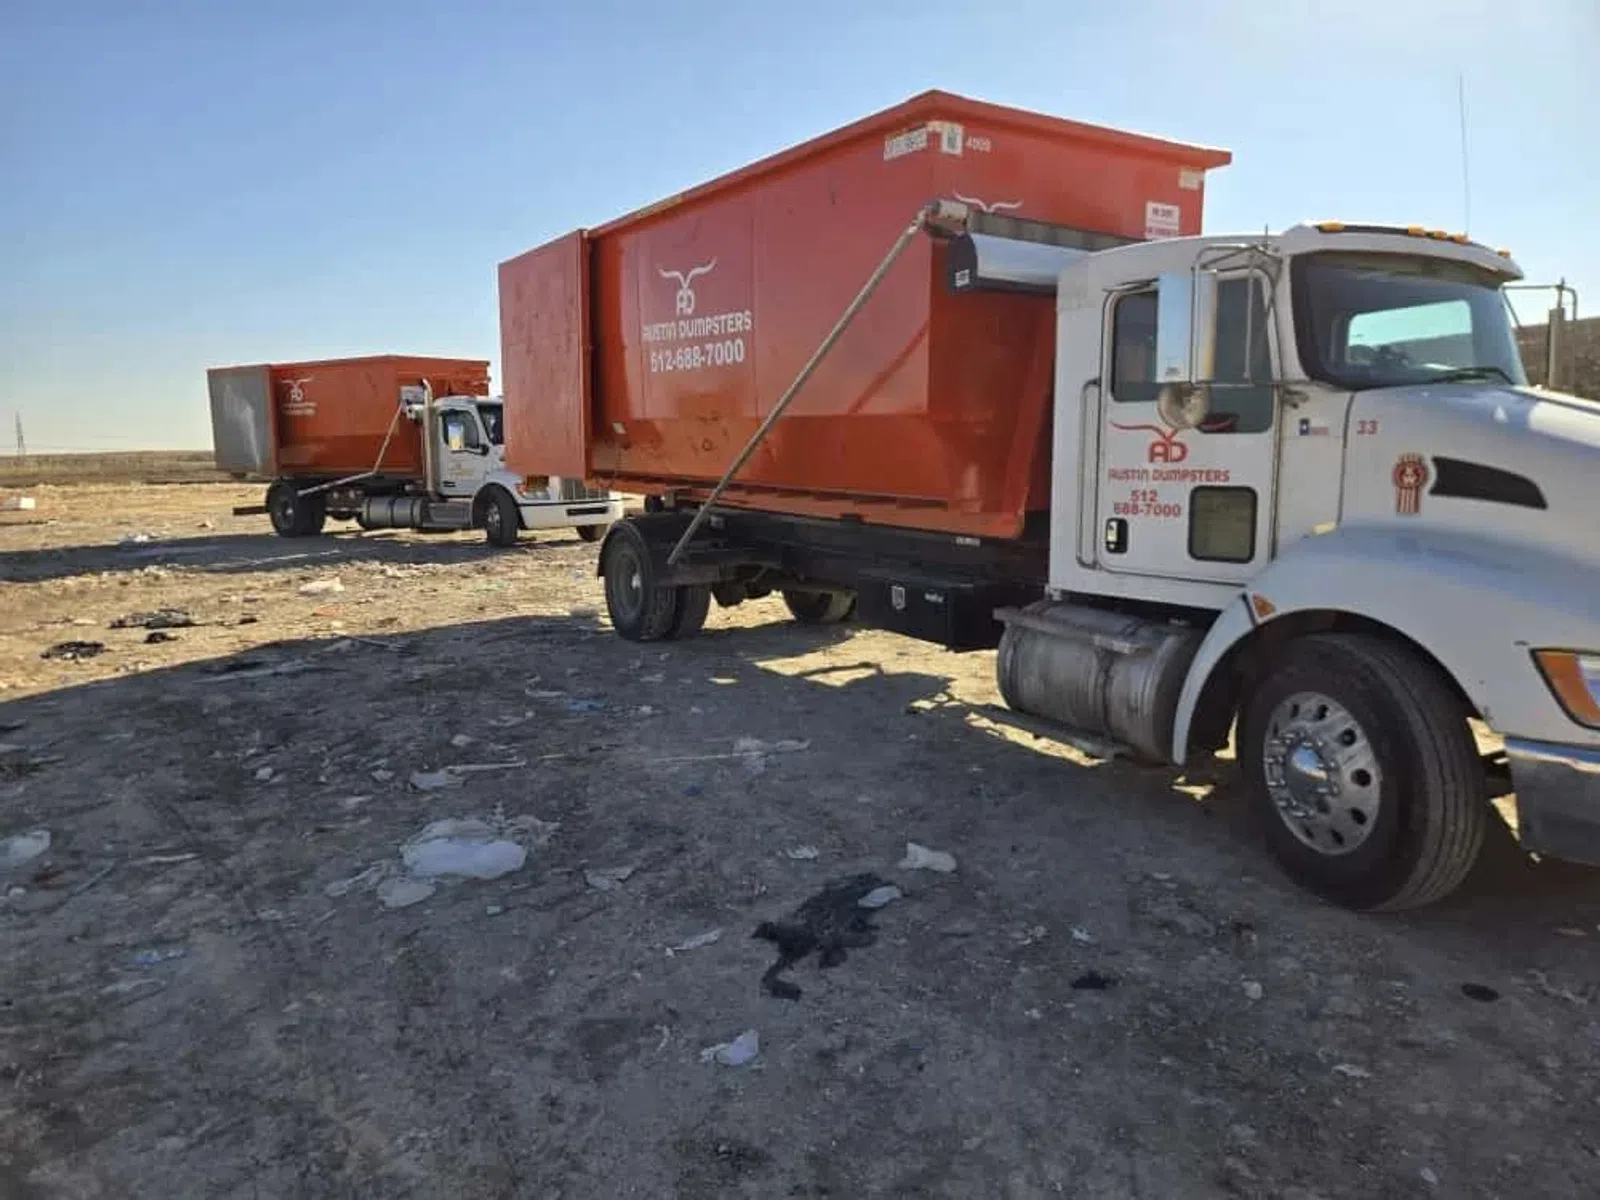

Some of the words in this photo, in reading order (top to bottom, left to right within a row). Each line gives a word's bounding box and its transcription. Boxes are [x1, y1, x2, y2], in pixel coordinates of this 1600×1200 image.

[642, 321, 677, 343] AUSTIN
[679, 310, 753, 338] DUMPSTERS
[1356, 419, 1377, 435] 33
[1147, 440, 1189, 463] AD
[1108, 468, 1150, 483] AUSTIN
[1151, 468, 1231, 483] DUMPSTERS
[1130, 489, 1159, 502] 512
[1113, 503, 1182, 518] 688-7000
